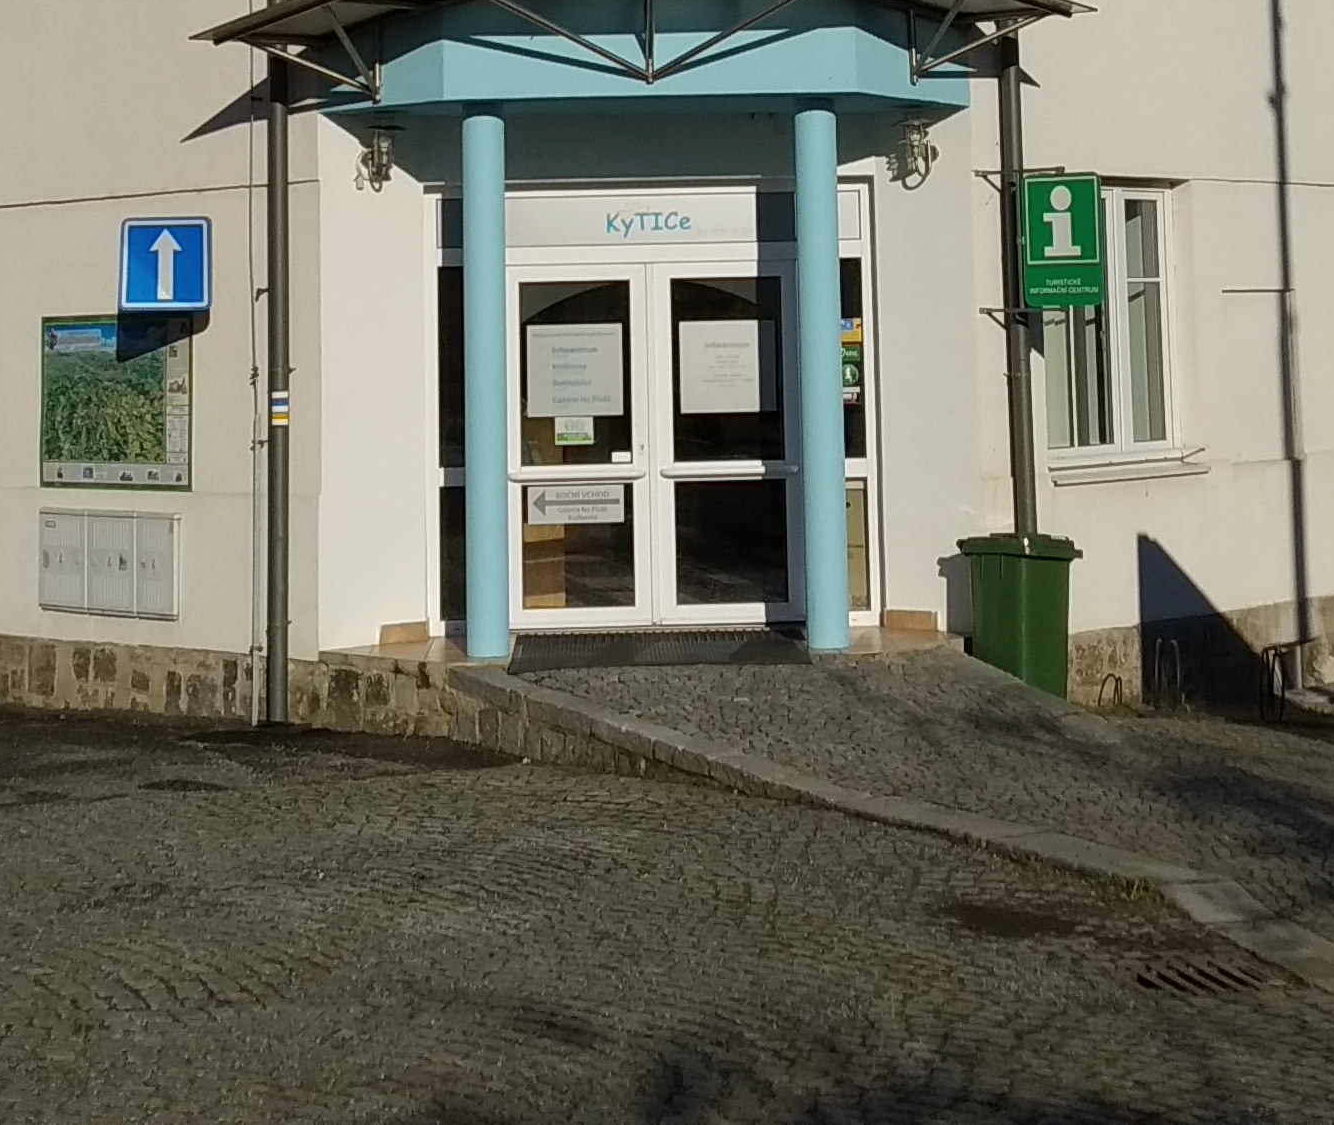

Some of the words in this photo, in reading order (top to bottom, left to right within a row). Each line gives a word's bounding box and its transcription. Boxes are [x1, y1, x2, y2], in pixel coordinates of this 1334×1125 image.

[606, 211, 692, 238] KyTICe
[1045, 278, 1082, 286] TURISTICKÉ
[1029, 286, 1067, 294] INFORMAČNÍ
[581, 490, 610, 498] VCHOD
